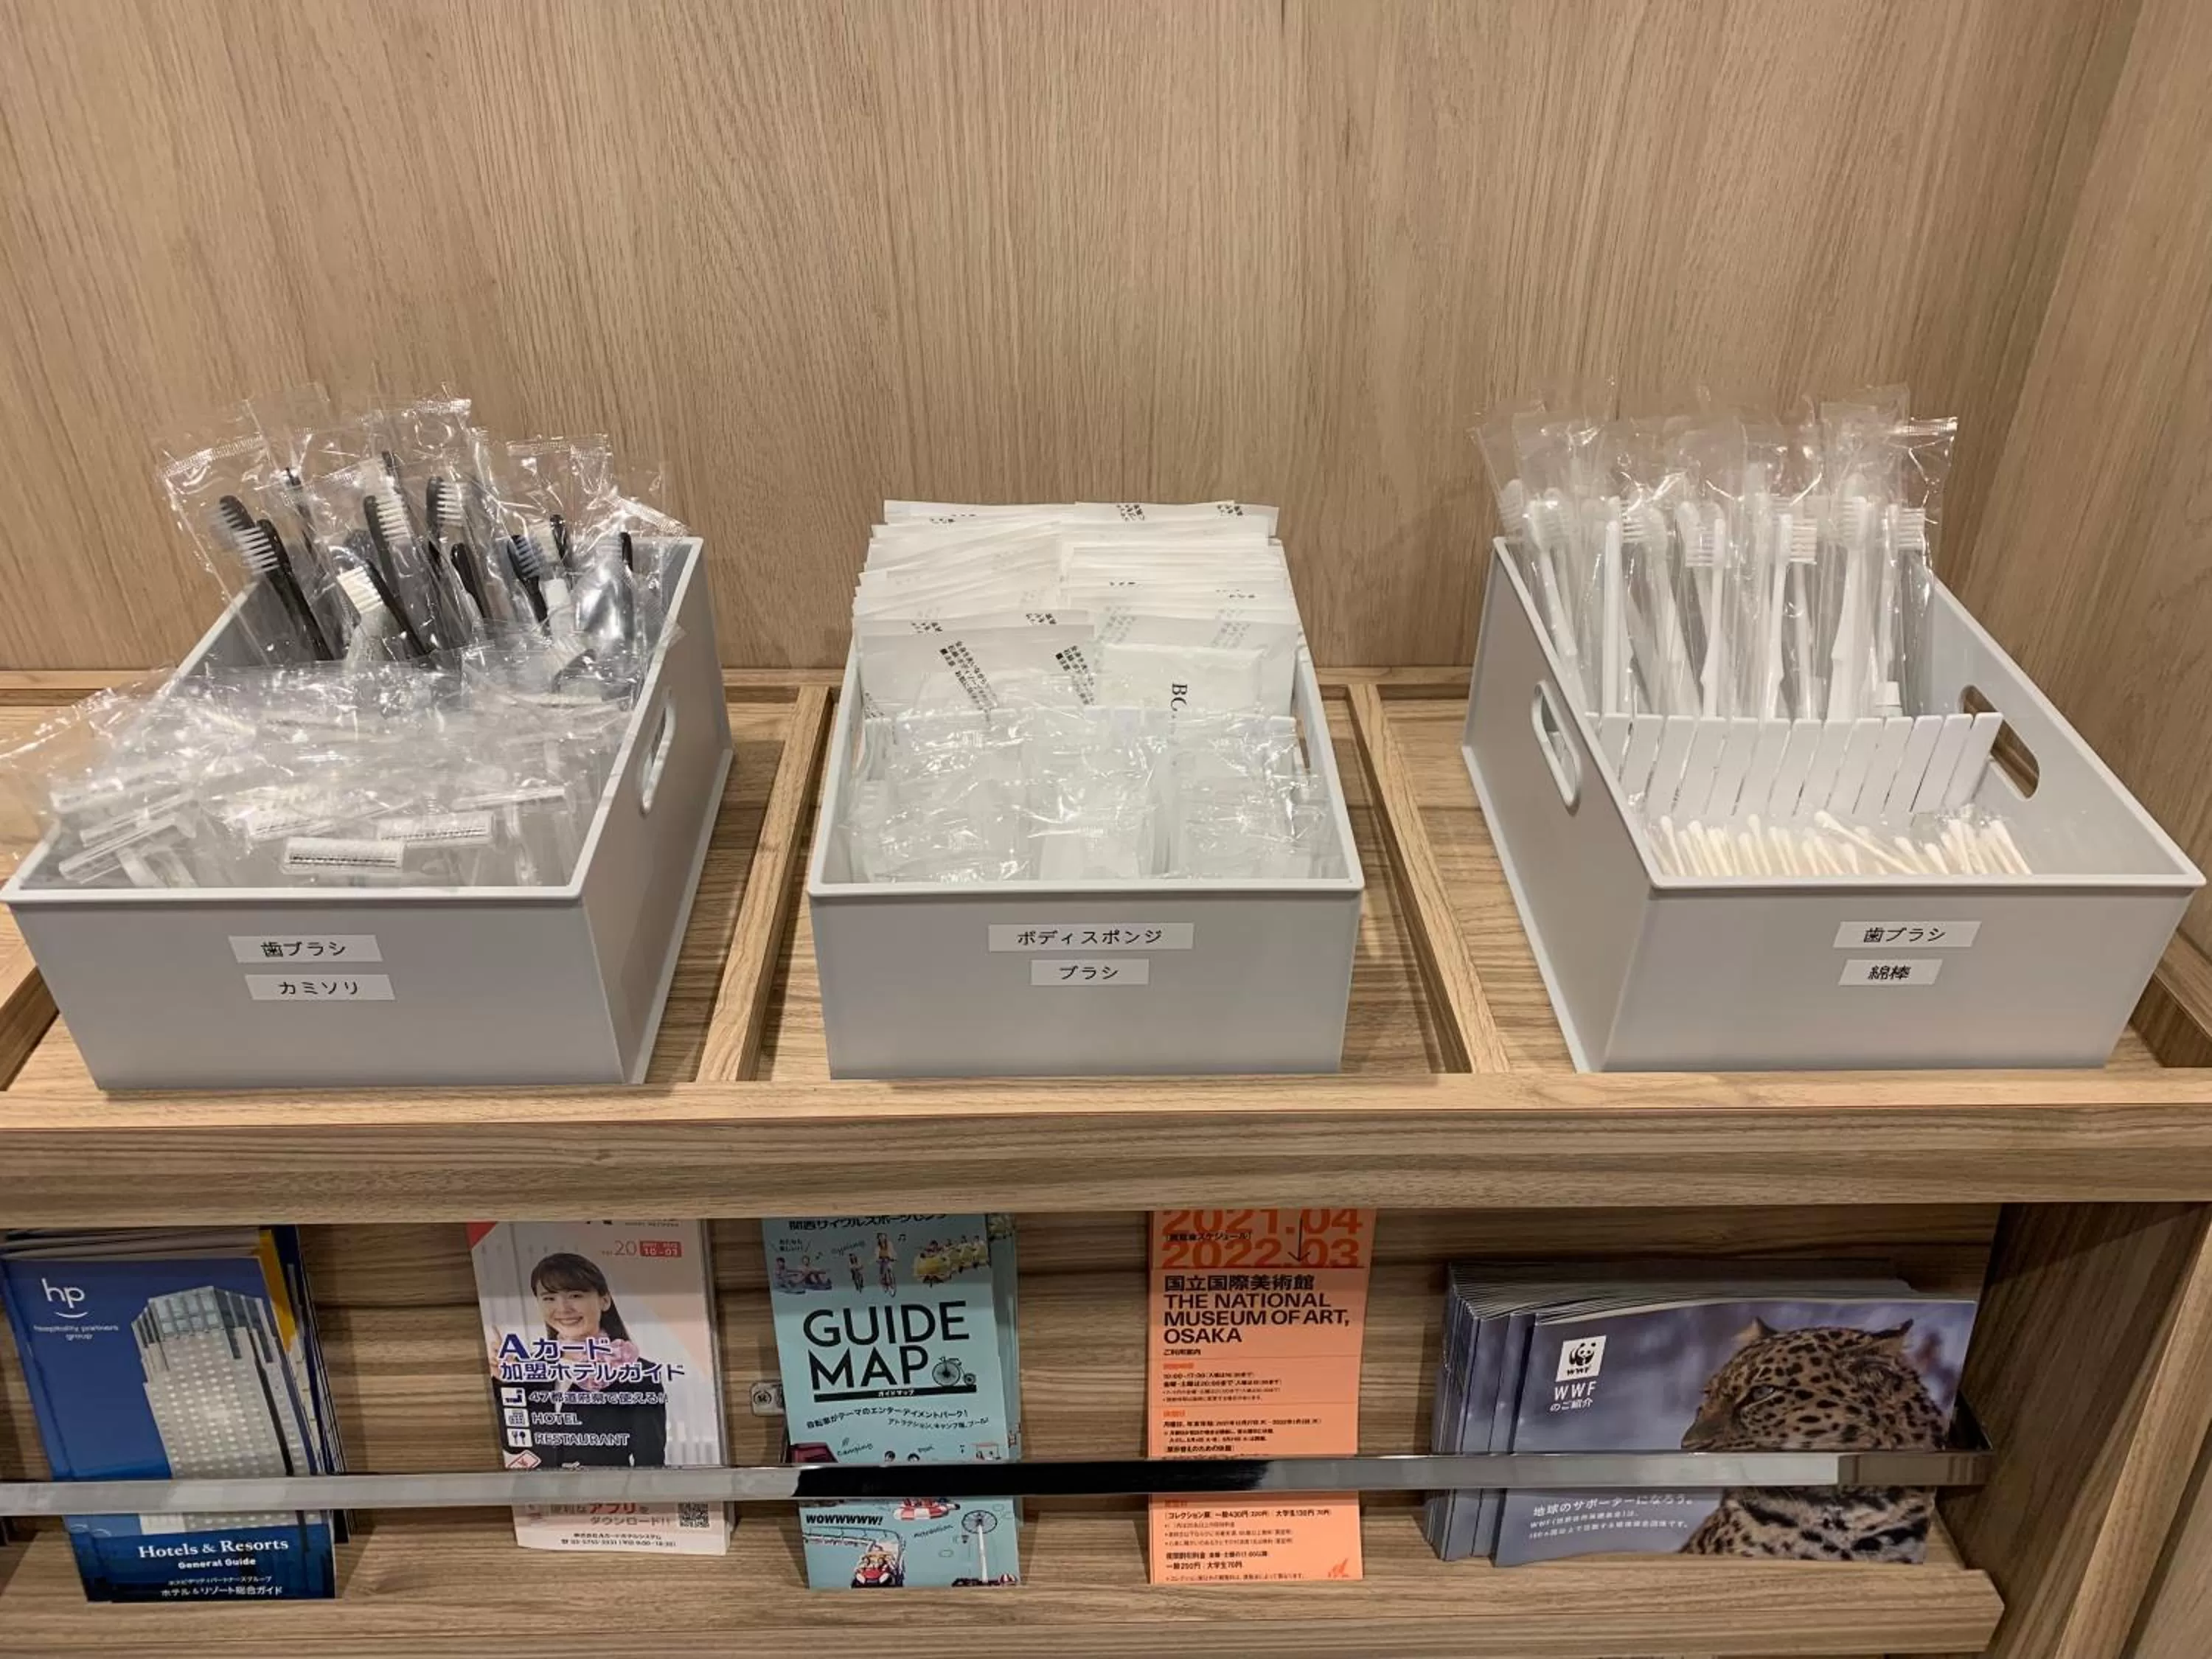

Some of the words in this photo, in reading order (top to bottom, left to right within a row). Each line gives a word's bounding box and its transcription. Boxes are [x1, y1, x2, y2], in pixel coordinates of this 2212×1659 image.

[1018, 930, 1163, 945] ボディスポンジ
[1863, 927, 1947, 943] 歯ブラシ
[260, 941, 346, 958] 歯ブラシ
[1060, 964, 1119, 980] ブラシ
[1868, 965, 1912, 980] 綿棒
[278, 981, 358, 995] カミソリ
[1161, 1238, 1360, 1268] 2022.03
[1164, 1274, 1315, 1290] 国立国際美術館
[41, 1278, 86, 1309] hp
[1164, 1294, 1208, 1310] THE
[1214, 1293, 1332, 1309] NATIONAL
[803, 1301, 970, 1348] GUIDE
[1164, 1310, 1267, 1326] MUSEUM
[1271, 1310, 1301, 1325] OF
[1302, 1309, 1350, 1327] ART,
[1164, 1328, 1242, 1345] OSAKA
[498, 1333, 612, 1360] Aカード
[501, 1363, 685, 1382] 加盟ホテルガイド
[808, 1345, 929, 1391] MAP
[1554, 1380, 1597, 1401] WWF
[532, 1412, 582, 1425] HOTEL
[534, 1433, 630, 1446] RESTAURANT
[138, 1543, 198, 1558] Hotels
[202, 1543, 218, 1554] &
[220, 1540, 289, 1553] Resorts
[178, 1558, 223, 1570] General
[225, 1557, 257, 1567] Guide
